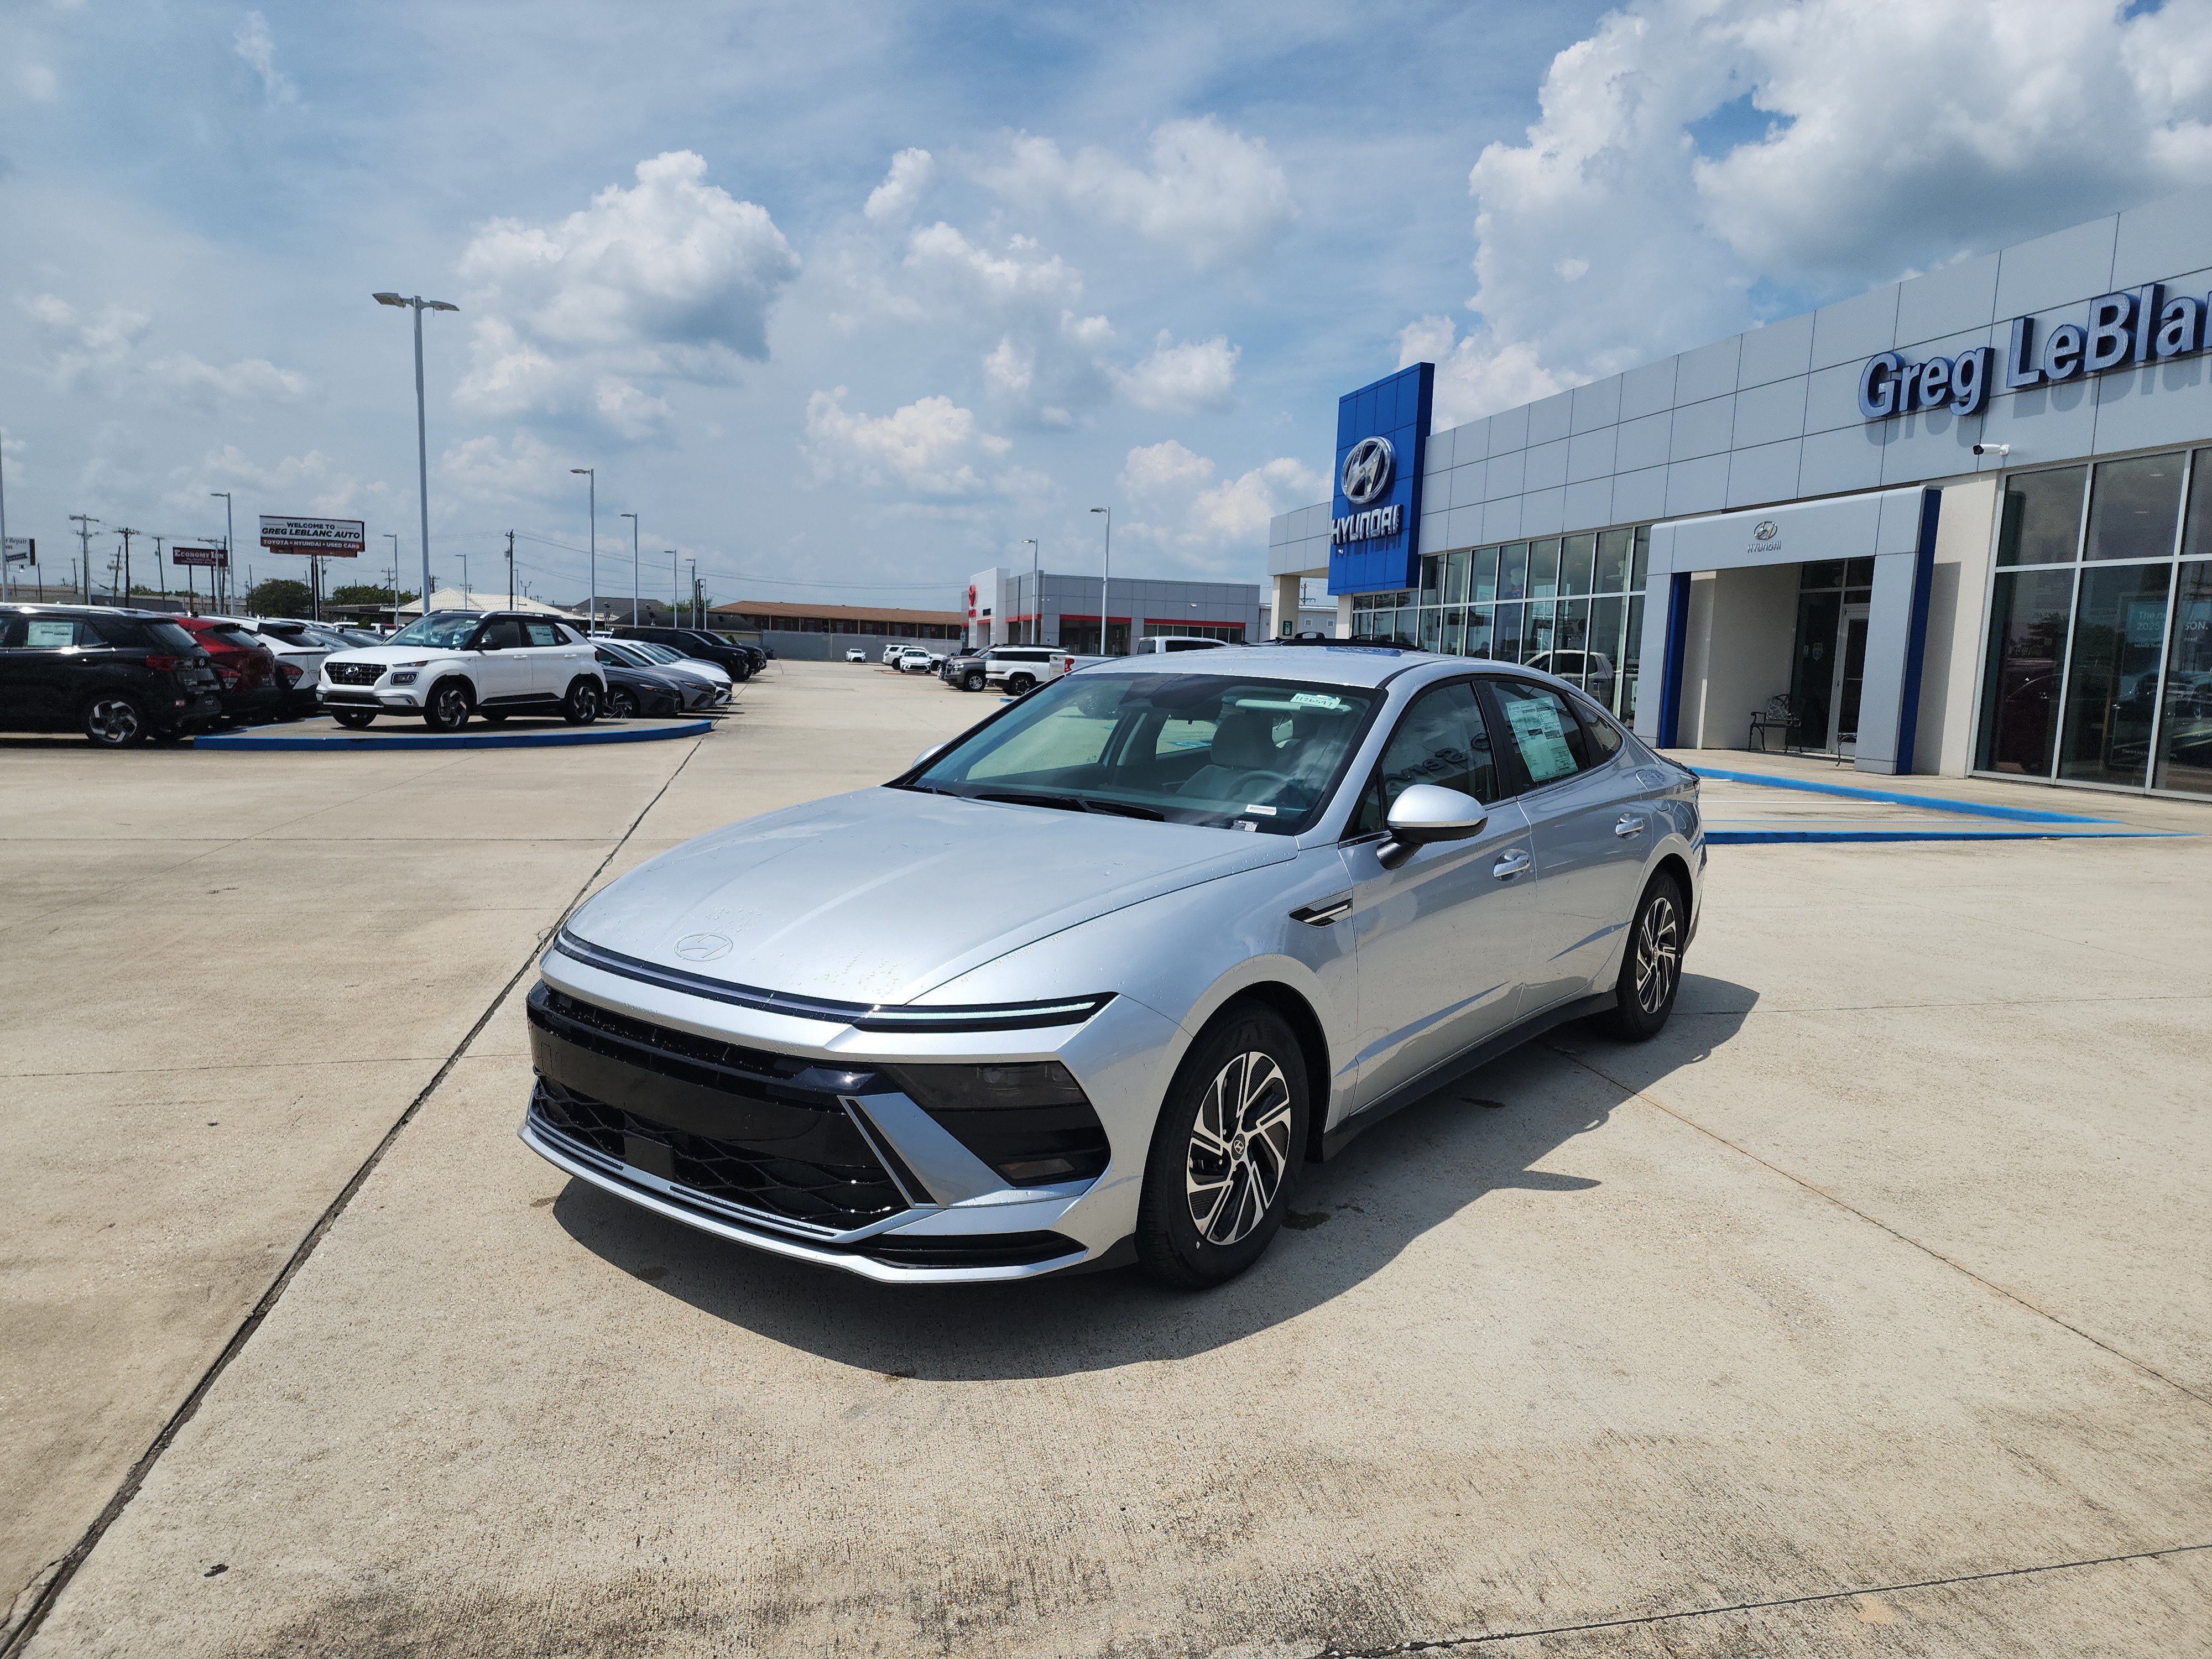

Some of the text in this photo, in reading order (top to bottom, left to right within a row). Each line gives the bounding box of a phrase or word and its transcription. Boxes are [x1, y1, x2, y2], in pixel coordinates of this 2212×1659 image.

[1858, 283, 2212, 418] Greg LeBla
[1331, 504, 1401, 545] HYUNDAI
[262, 527, 361, 539] GREG LEBLANC AUTO
[1747, 541, 1782, 554] HYUNDAI
[211, 550, 224, 559] IN
